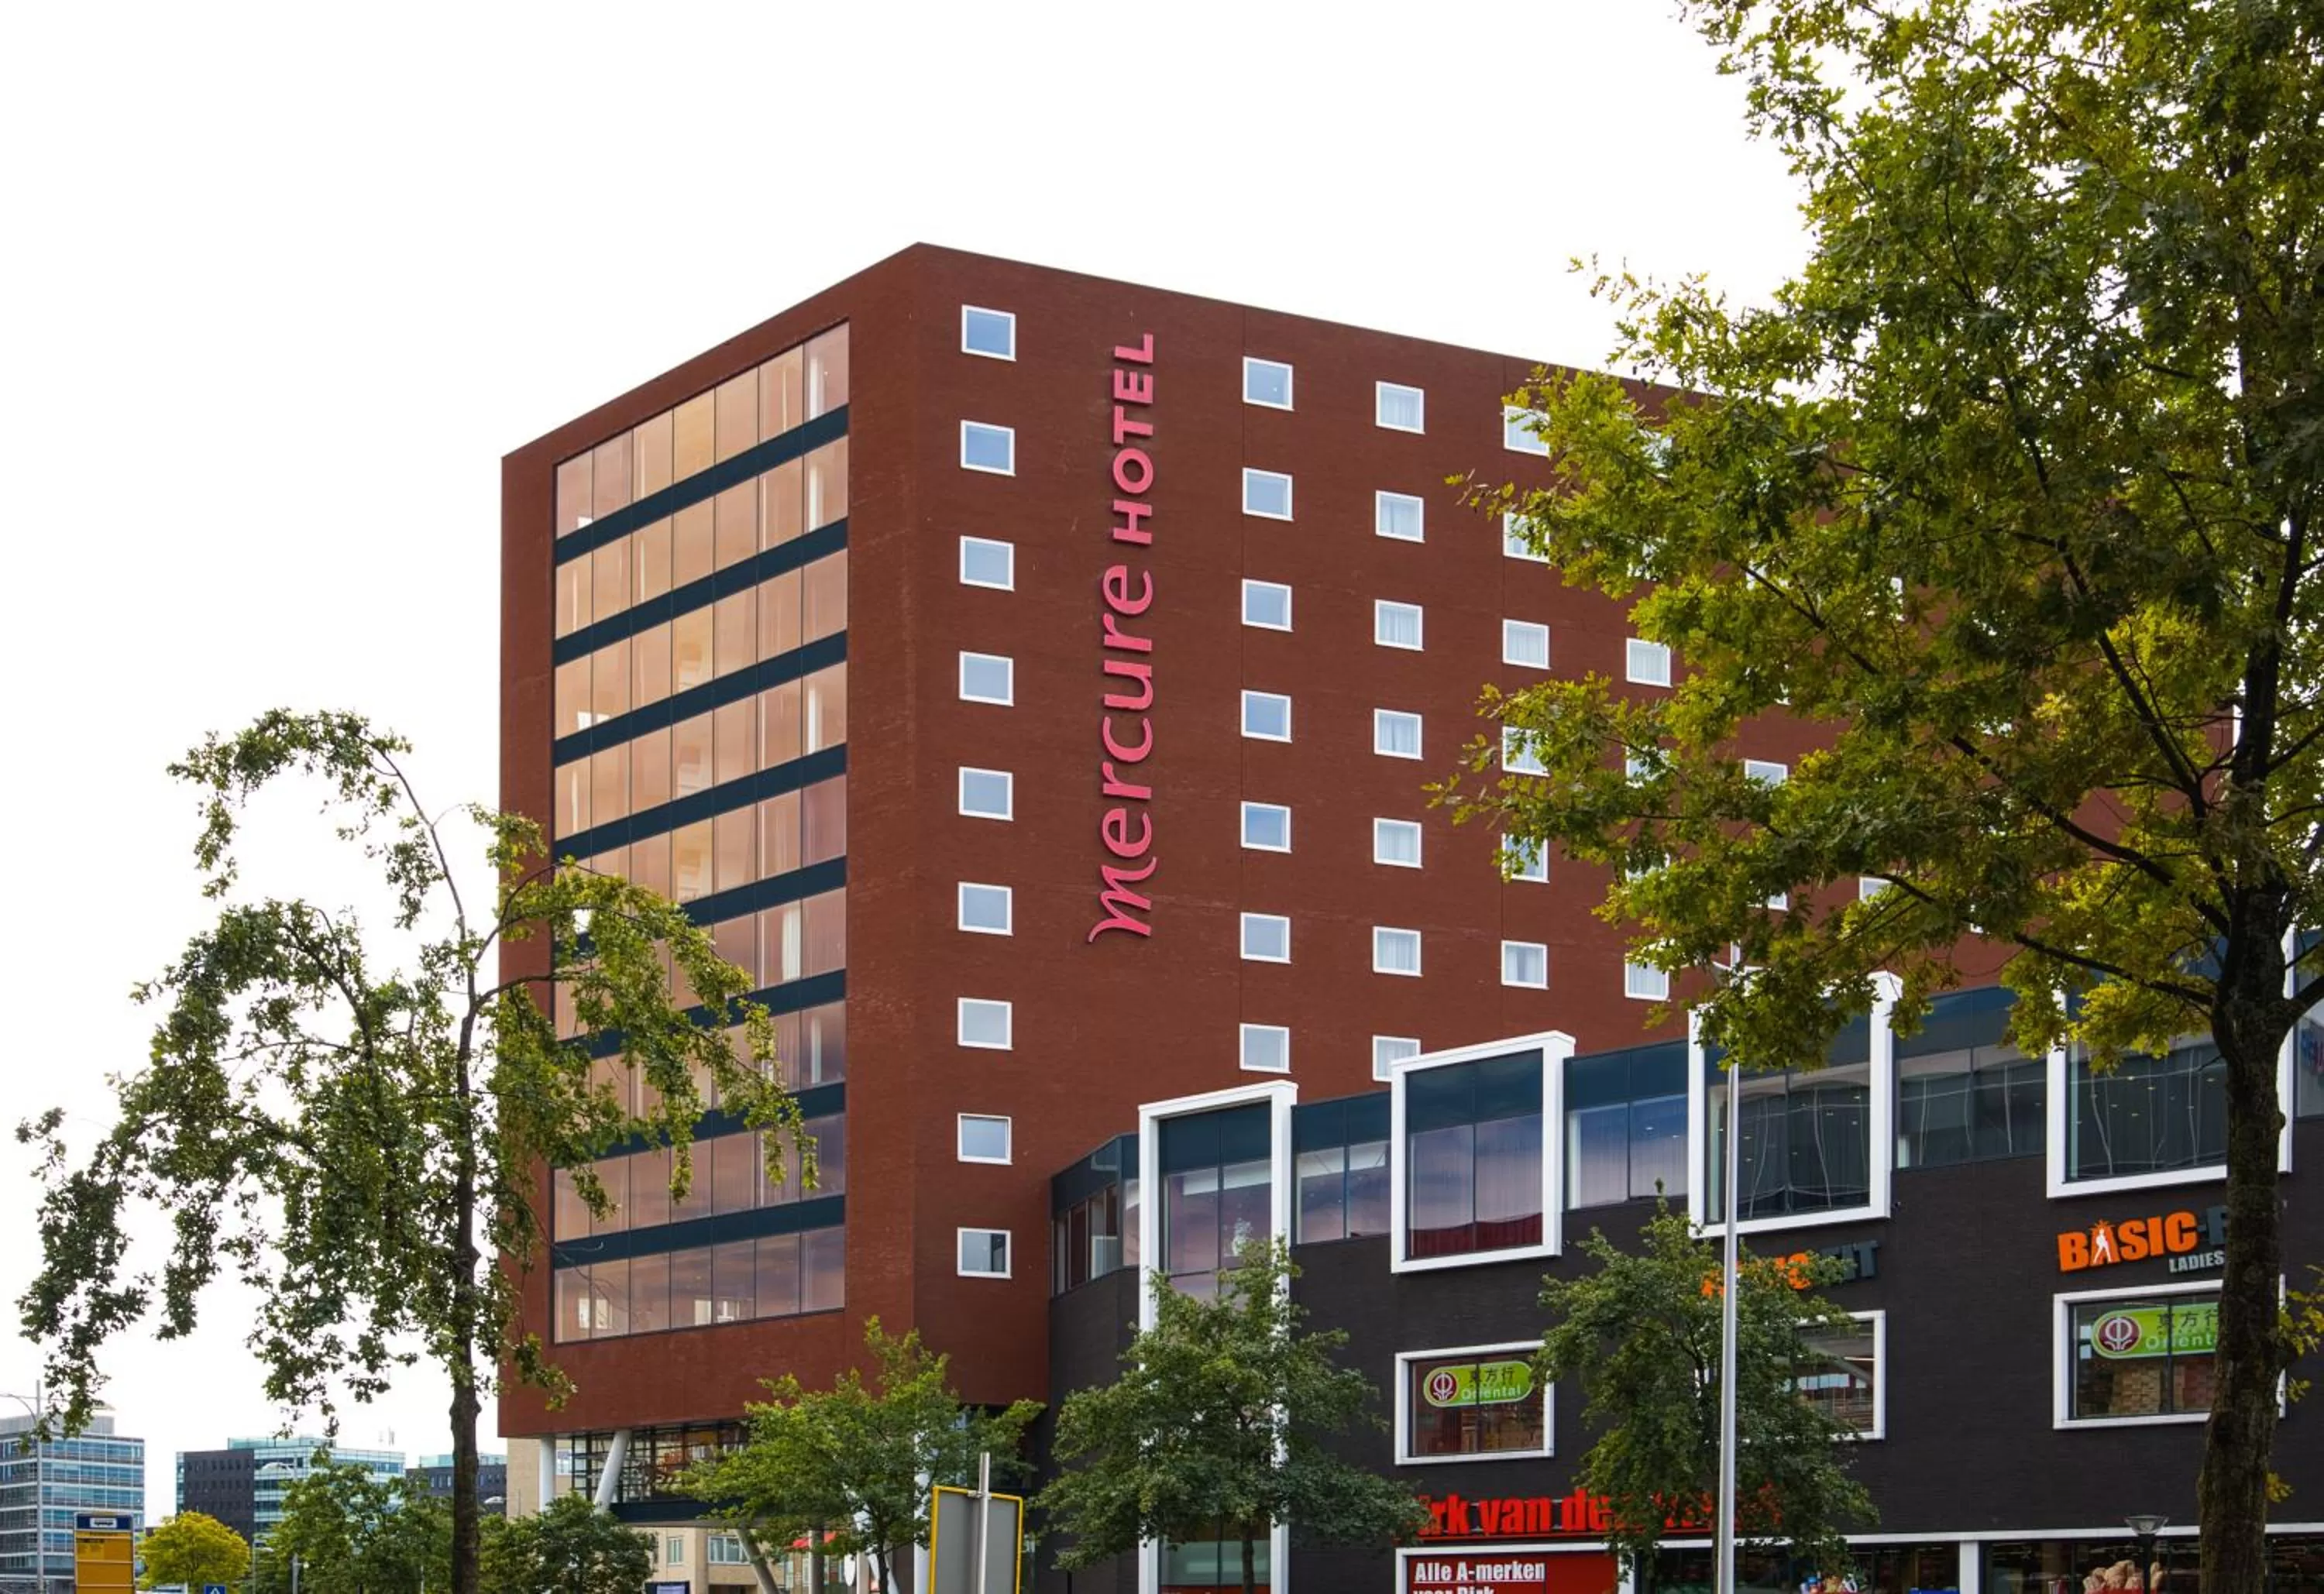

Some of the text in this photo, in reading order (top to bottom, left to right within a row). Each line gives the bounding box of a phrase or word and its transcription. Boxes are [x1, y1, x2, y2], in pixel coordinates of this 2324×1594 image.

[1113, 334, 1153, 545] HOTEL
[2169, 1250, 2226, 1273] LADIES
[1479, 1496, 1550, 1535] van
[1561, 1487, 1622, 1532] de
[1415, 1559, 1545, 1582] Alle A-merken
